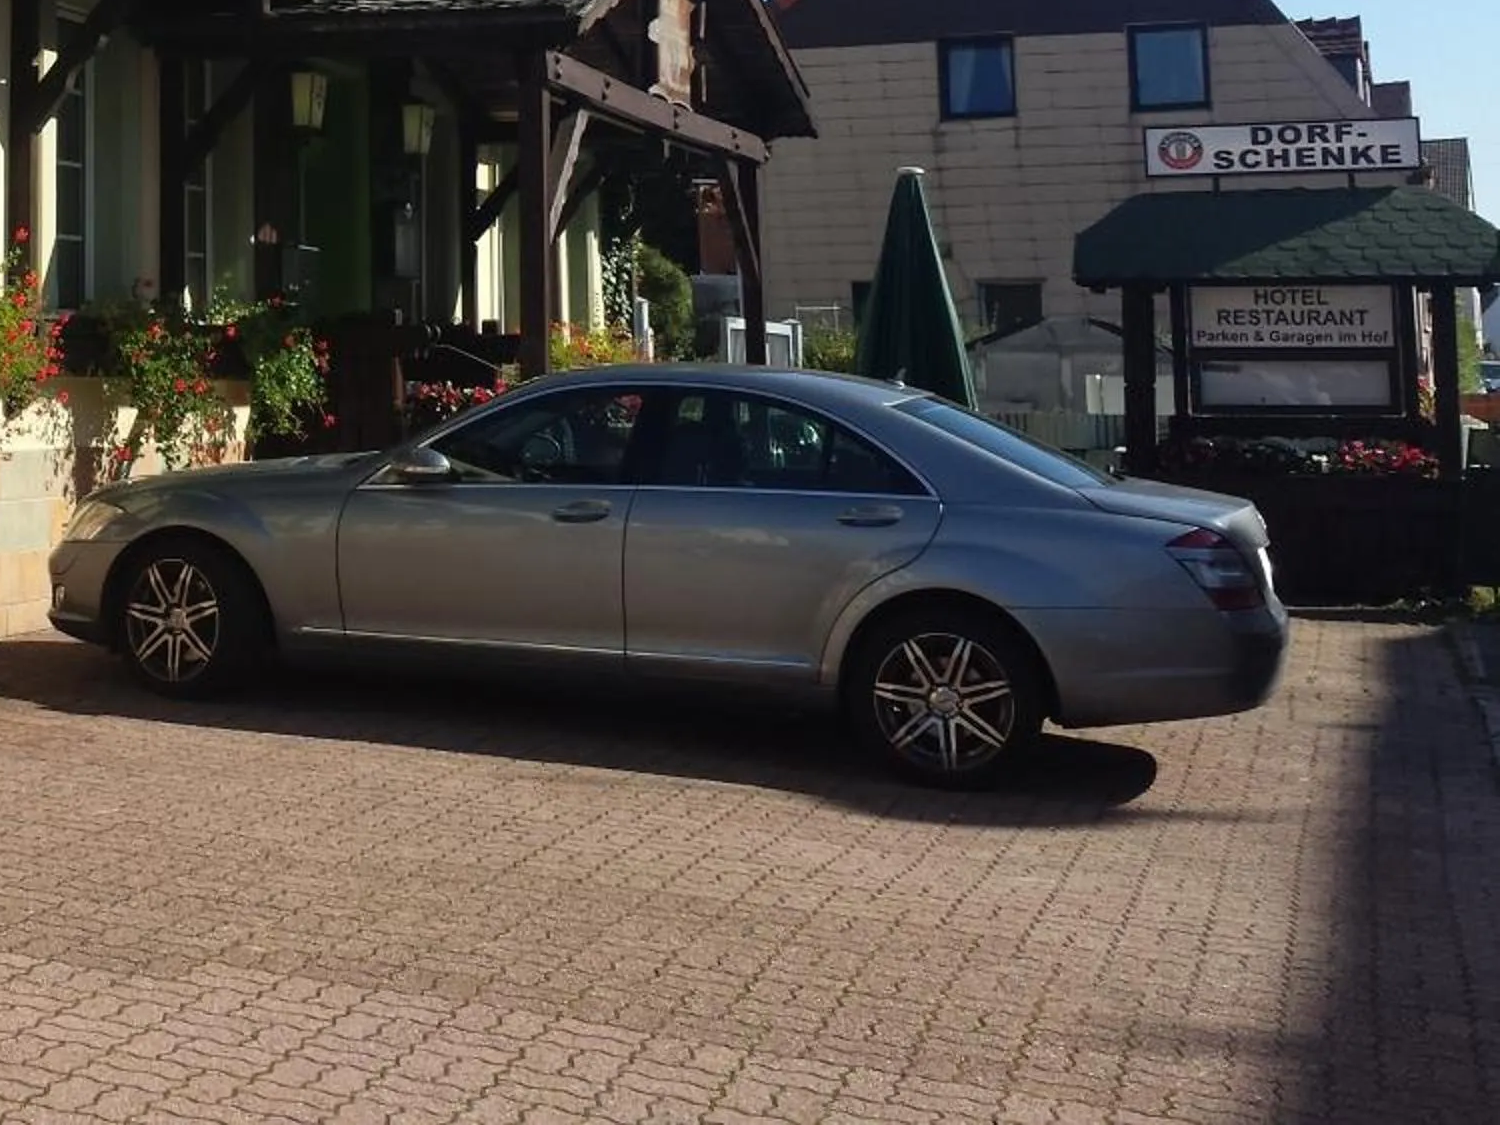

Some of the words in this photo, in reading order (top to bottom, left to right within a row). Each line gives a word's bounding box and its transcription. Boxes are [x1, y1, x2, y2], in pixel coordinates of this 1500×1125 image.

[1251, 123, 1368, 146] DORF-
[1213, 144, 1402, 170] SCHENKE
[1253, 288, 1329, 306] HOTEL
[1216, 309, 1369, 326] RESTAURANT
[1197, 330, 1249, 342] Parken
[1253, 330, 1264, 342] &
[1269, 330, 1333, 345] Garagen
[1338, 330, 1357, 342] im
[1361, 330, 1389, 342] Hof
